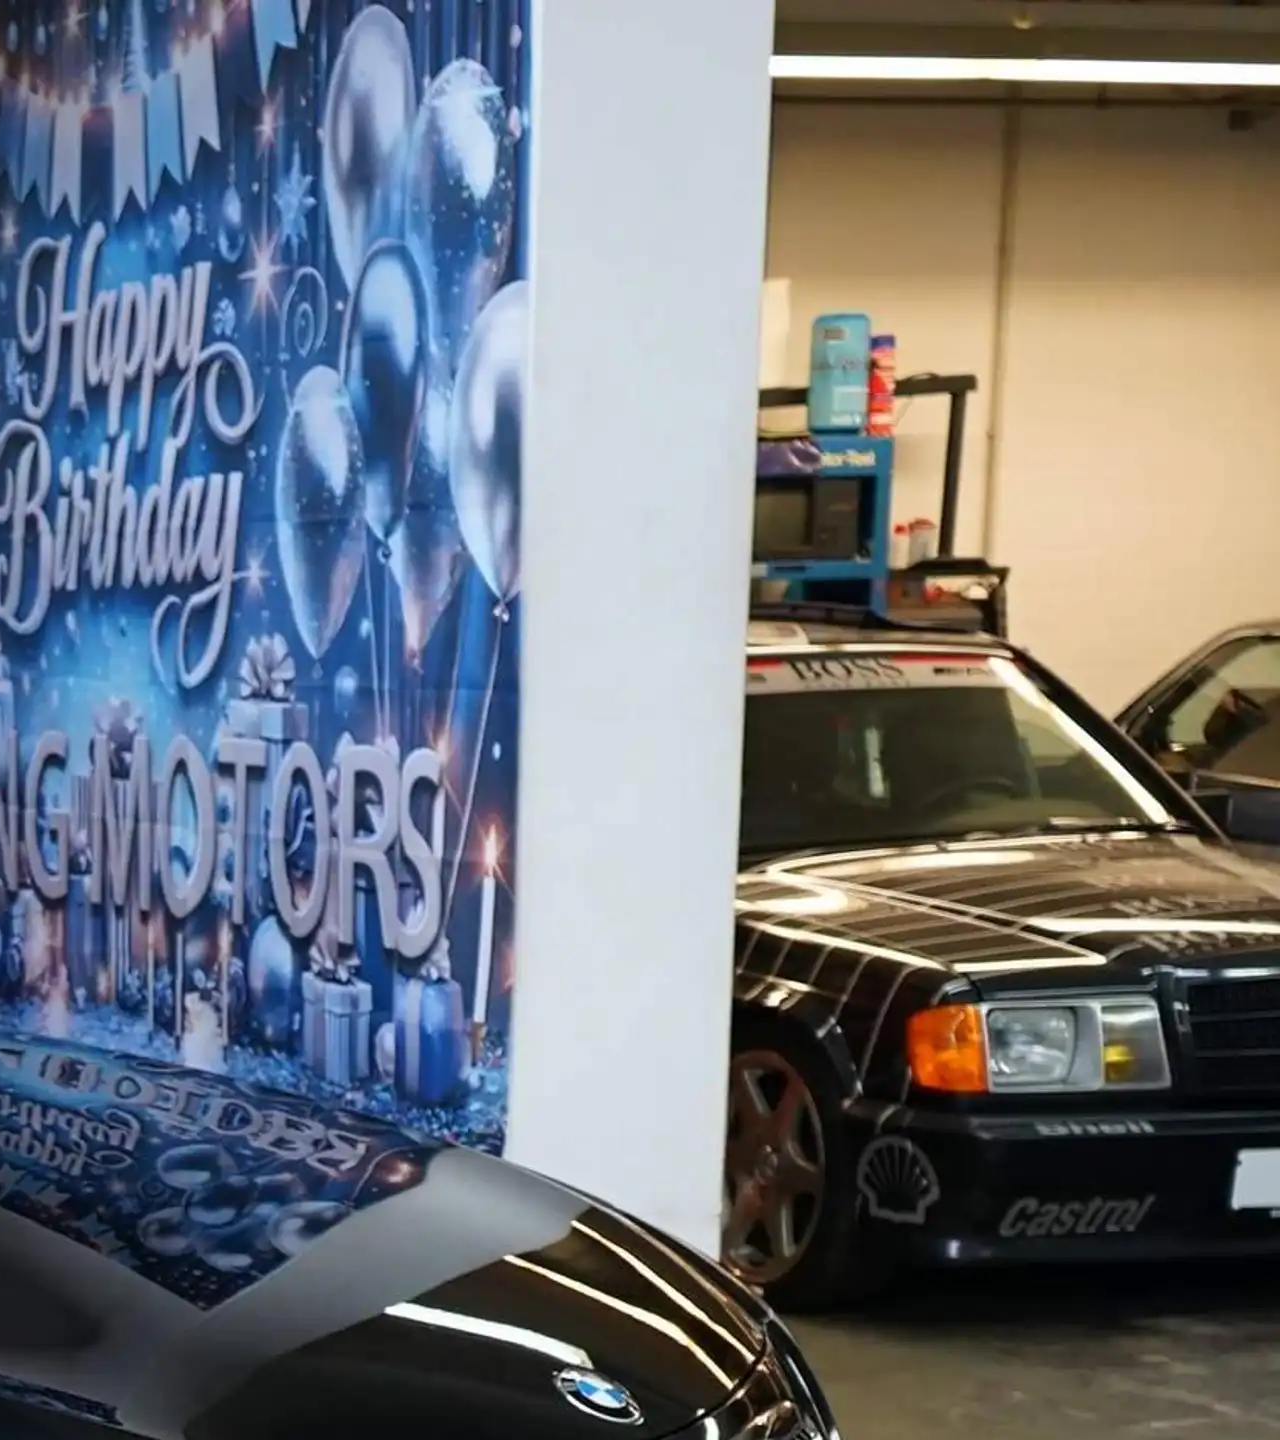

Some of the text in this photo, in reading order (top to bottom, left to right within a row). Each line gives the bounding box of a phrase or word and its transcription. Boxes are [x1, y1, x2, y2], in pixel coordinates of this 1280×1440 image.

[16, 220, 262, 450] Happy
[790, 654, 905, 681] BOSS
[89, 730, 446, 958] MOTORS
[998, 1194, 1156, 1238] Castrol
